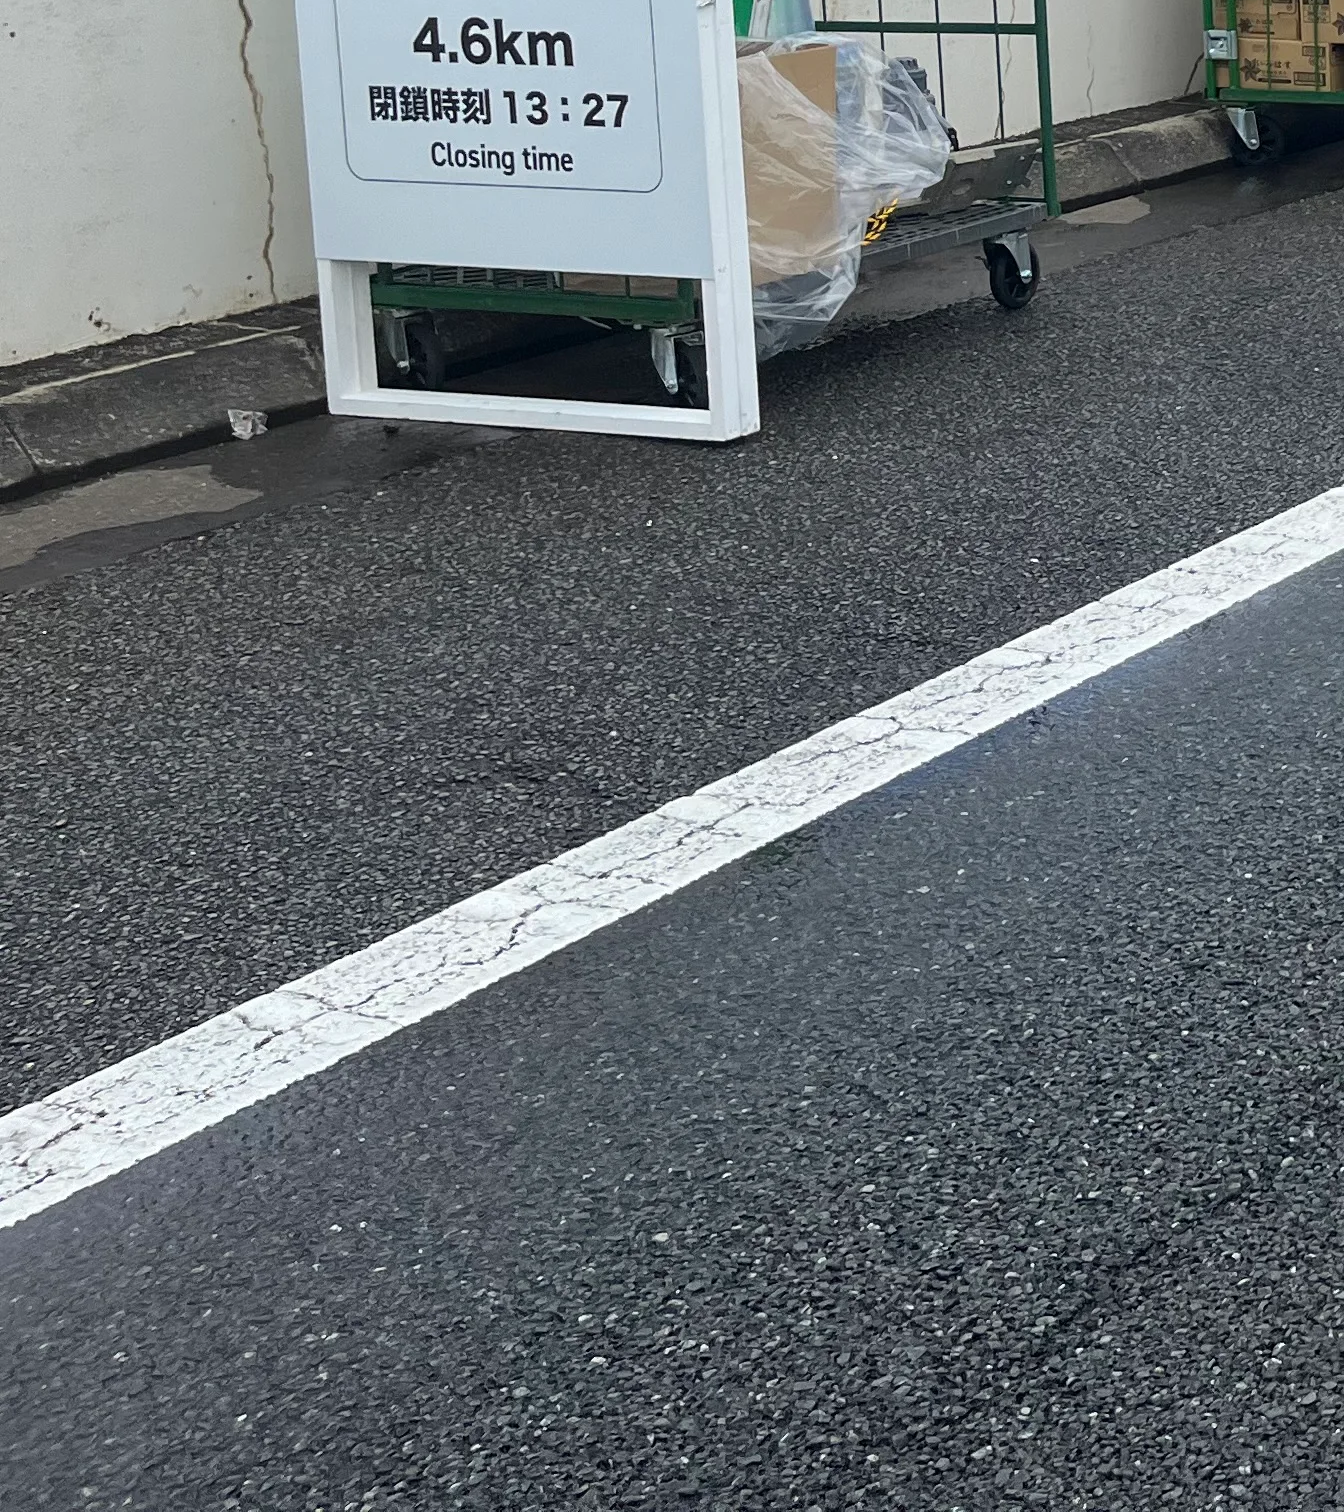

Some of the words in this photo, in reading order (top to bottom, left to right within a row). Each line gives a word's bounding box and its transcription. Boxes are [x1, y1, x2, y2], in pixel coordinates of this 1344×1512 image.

[412, 16, 575, 67] 4.6km
[367, 84, 492, 126] 閉鎖時刻
[502, 90, 630, 128] 13:27
[430, 141, 515, 177] Closing
[522, 145, 574, 174] time
